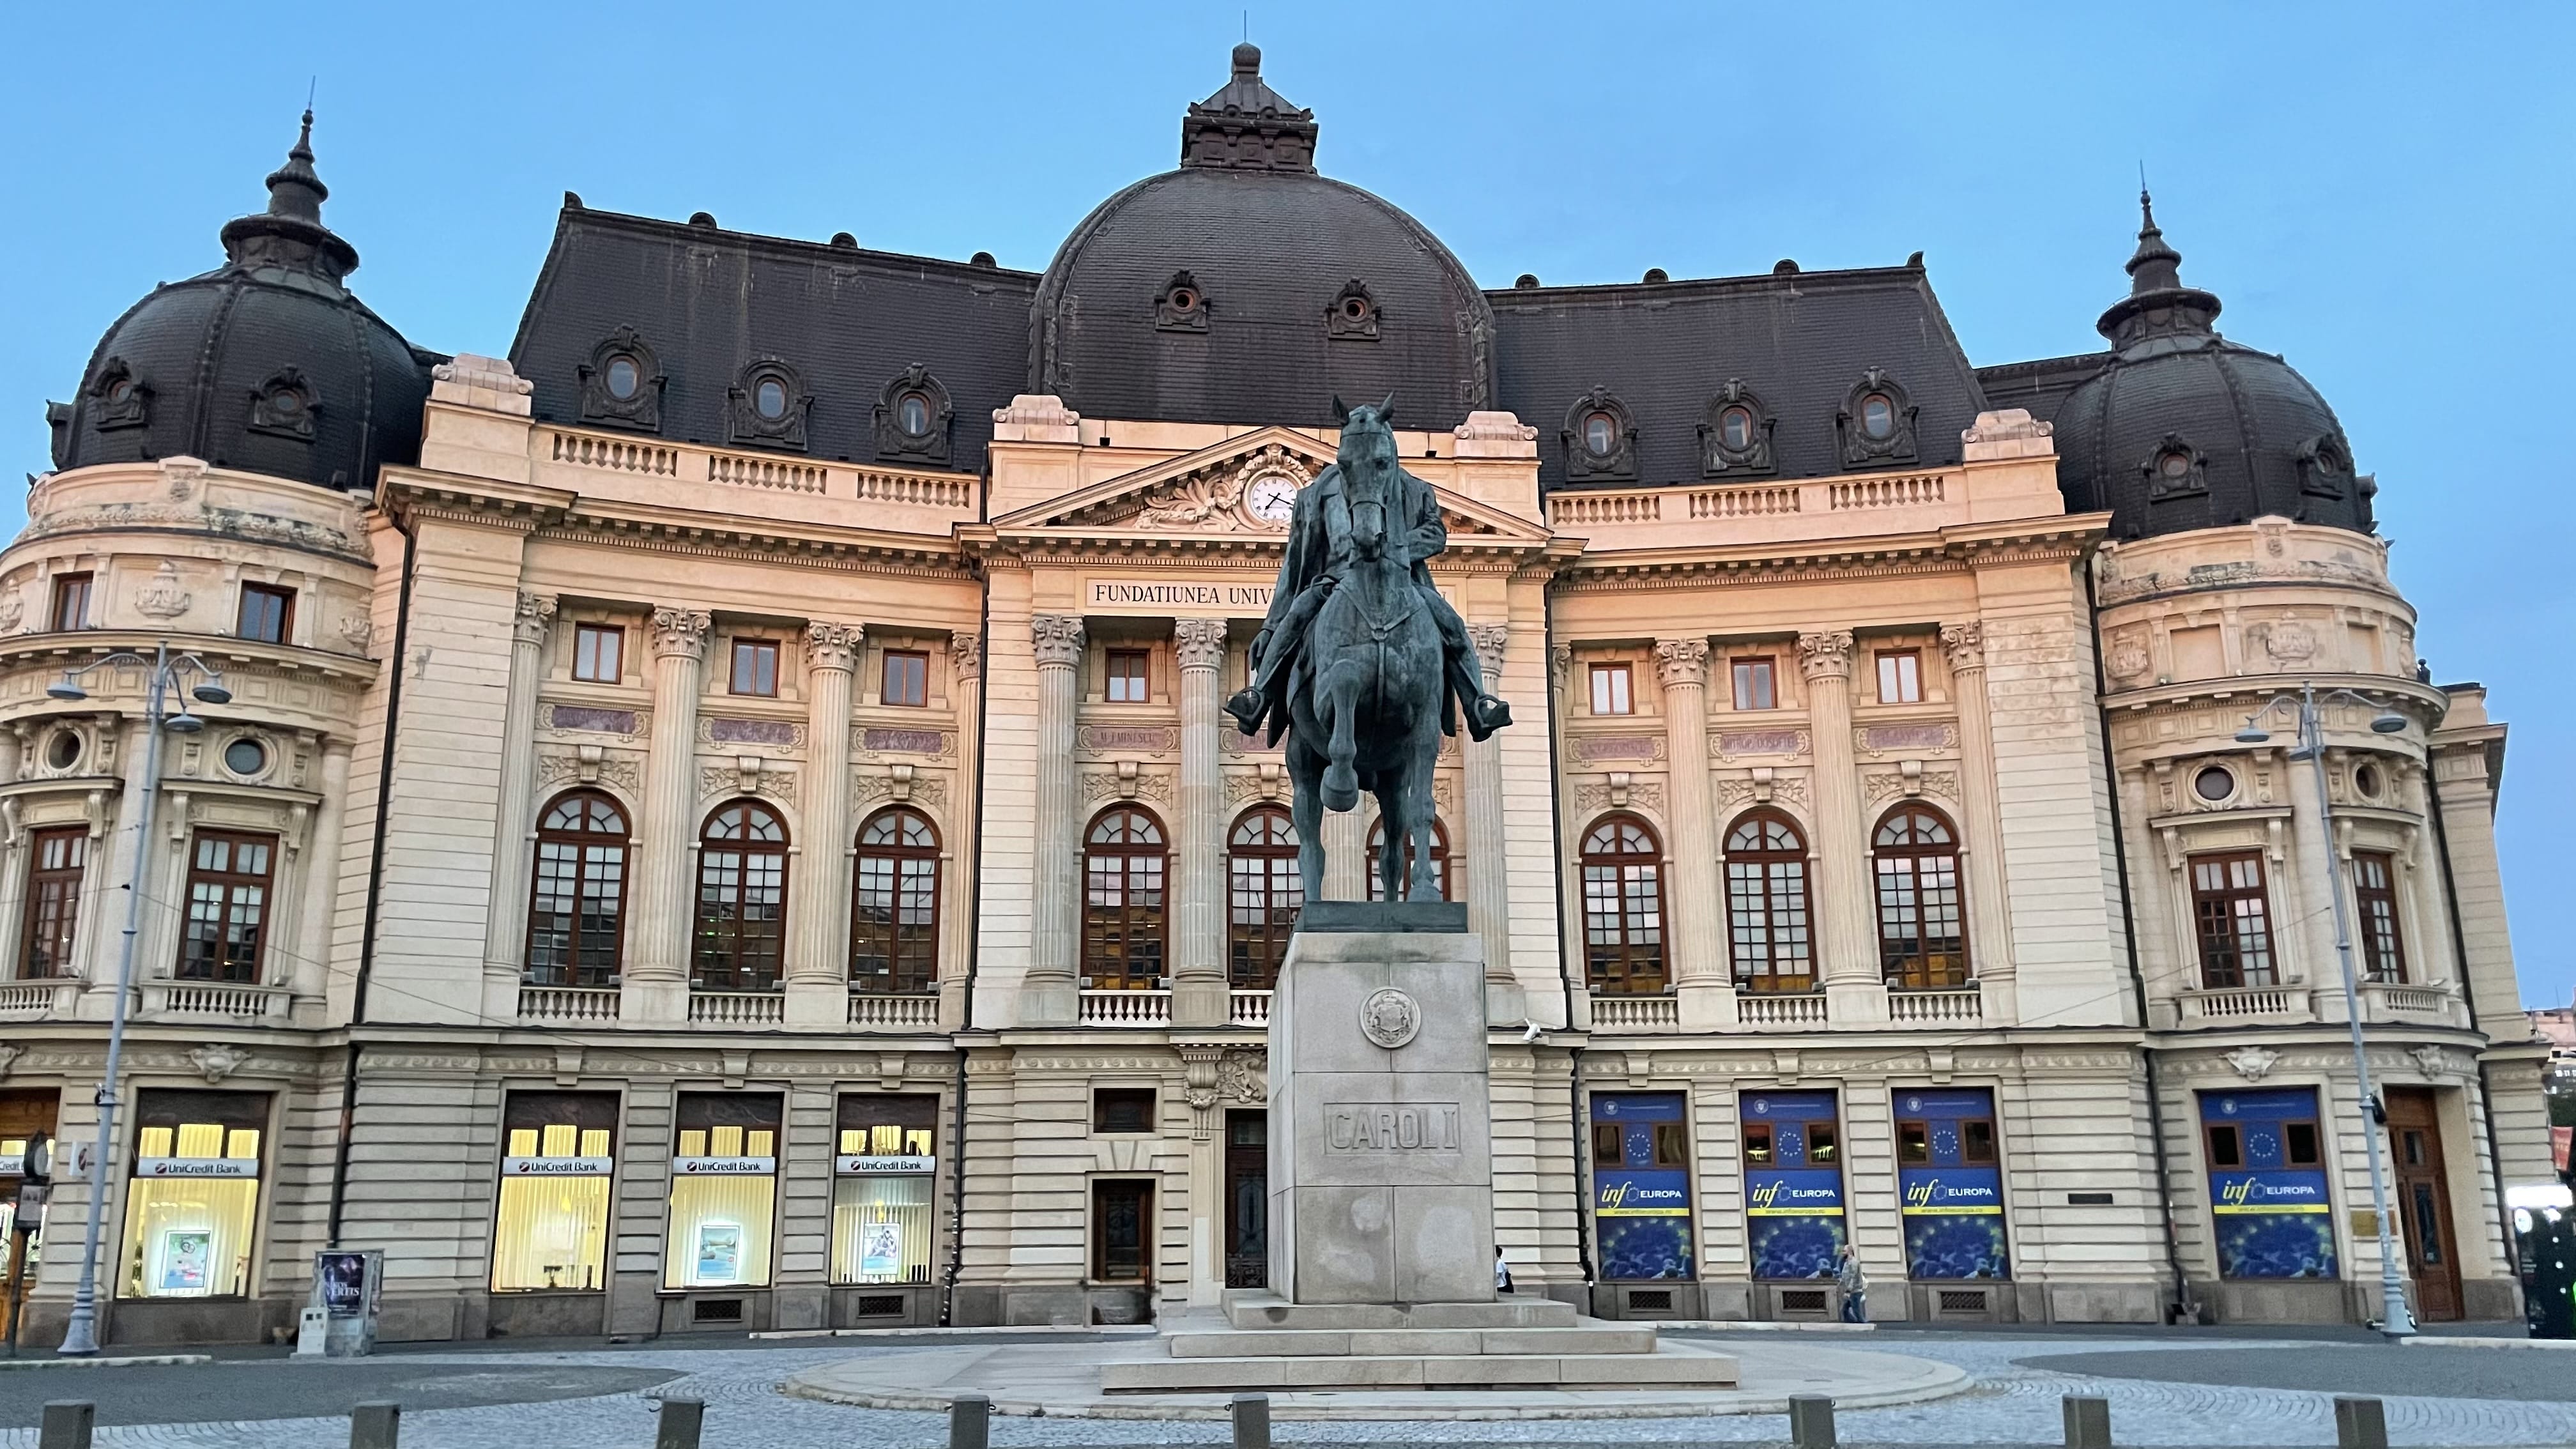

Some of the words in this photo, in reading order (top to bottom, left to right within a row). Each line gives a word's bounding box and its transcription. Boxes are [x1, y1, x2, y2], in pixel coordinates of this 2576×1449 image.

[1095, 585, 1220, 604] FUNDATIUNEA
[1229, 588, 1276, 604] UNIV
[1330, 1108, 1438, 1149] CAROL
[1442, 1108, 1457, 1149] I
[168, 1163, 213, 1174] UniCredit
[216, 1163, 241, 1174] Bank
[531, 1162, 572, 1172] UniCredit
[574, 1162, 598, 1171] Bank
[698, 1162, 737, 1170] UniCredit
[739, 1162, 761, 1170] Bank
[862, 1161, 899, 1170] UniCredit
[901, 1161, 921, 1170] Bank
[1948, 1188, 1993, 1196] EUROPA
[2267, 1186, 2315, 1195] EUROPA
